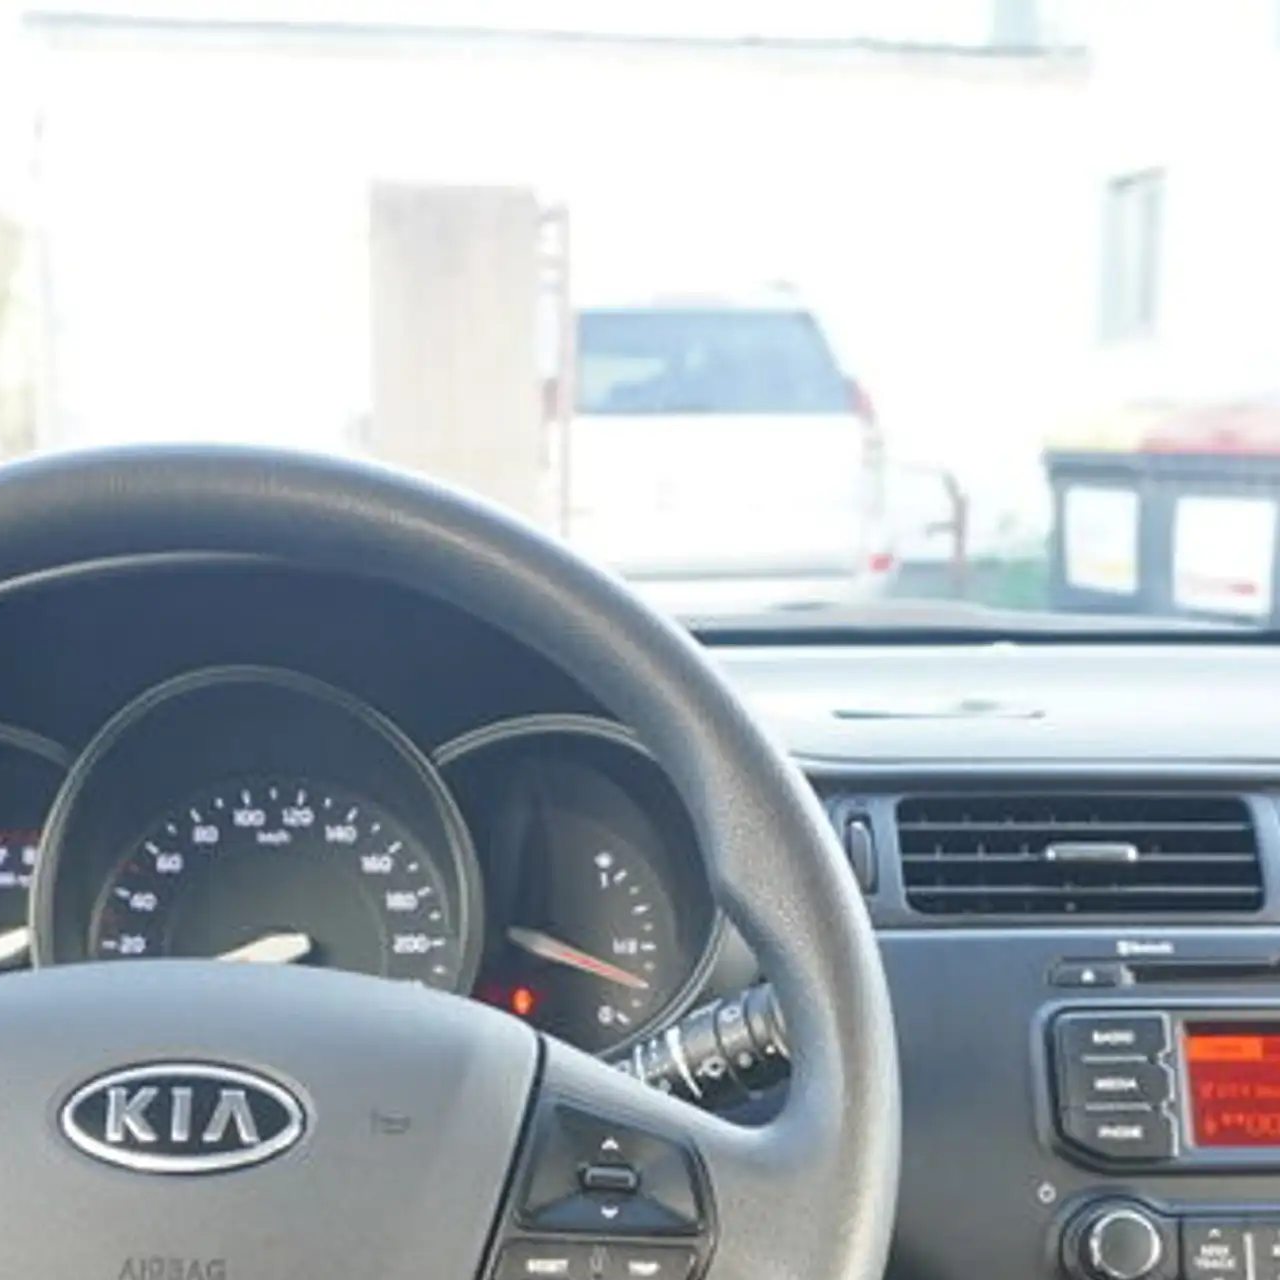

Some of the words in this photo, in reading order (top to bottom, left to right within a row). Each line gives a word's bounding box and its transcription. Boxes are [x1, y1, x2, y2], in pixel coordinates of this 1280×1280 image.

[233, 809, 266, 826] 100
[282, 807, 315, 826] 120
[193, 825, 219, 843] 80
[325, 825, 357, 842] 140
[156, 853, 183, 872] 60
[361, 856, 394, 873] 160
[129, 892, 157, 911] 40
[120, 934, 146, 953] 20
[393, 933, 430, 953] 200
[104, 1085, 260, 1144] KIA
